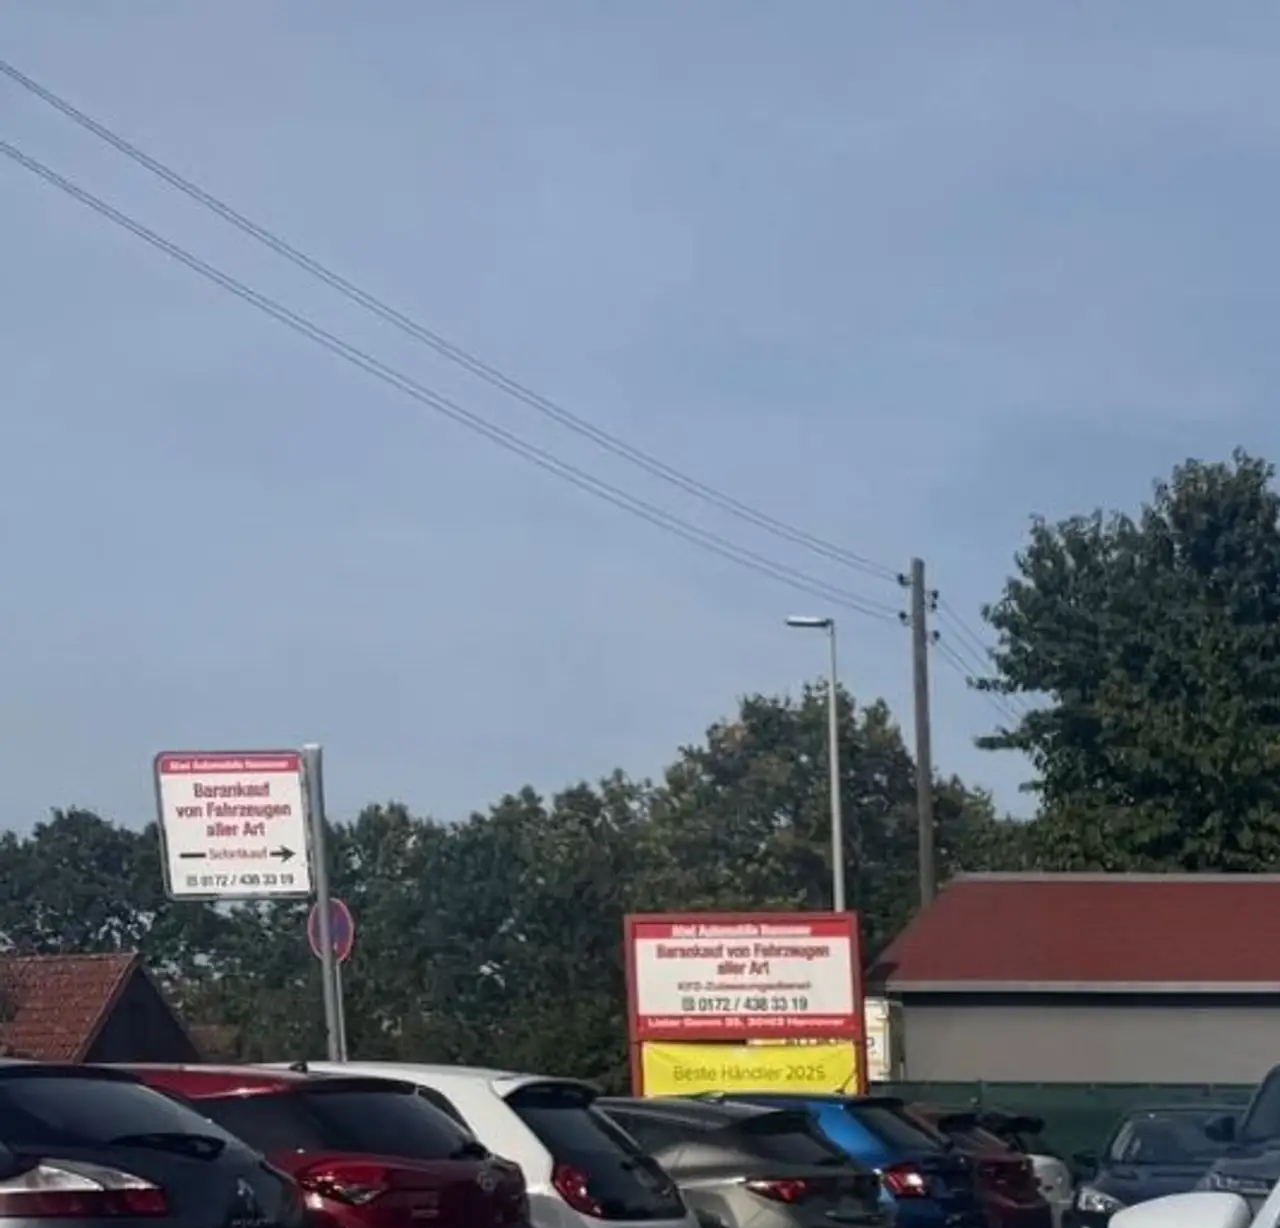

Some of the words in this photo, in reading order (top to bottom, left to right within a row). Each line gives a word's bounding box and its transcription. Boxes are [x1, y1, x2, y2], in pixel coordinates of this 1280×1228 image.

[193, 782, 270, 798] Barankauf
[176, 806, 202, 817] von
[206, 802, 292, 819] Fahrzeugen
[206, 822, 238, 837] aller
[243, 821, 265, 836] Art
[200, 874, 228, 888] 0172
[726, 946, 750, 959] von
[754, 943, 830, 960] Fahrzeugen
[717, 962, 745, 975] aller
[750, 961, 769, 975] Art
[698, 997, 731, 1011] 0172
[744, 997, 768, 1011] 438
[771, 997, 788, 1011] 33
[792, 997, 808, 1011] 19
[672, 1064, 717, 1081] Beste
[721, 1062, 783, 1081] Händler
